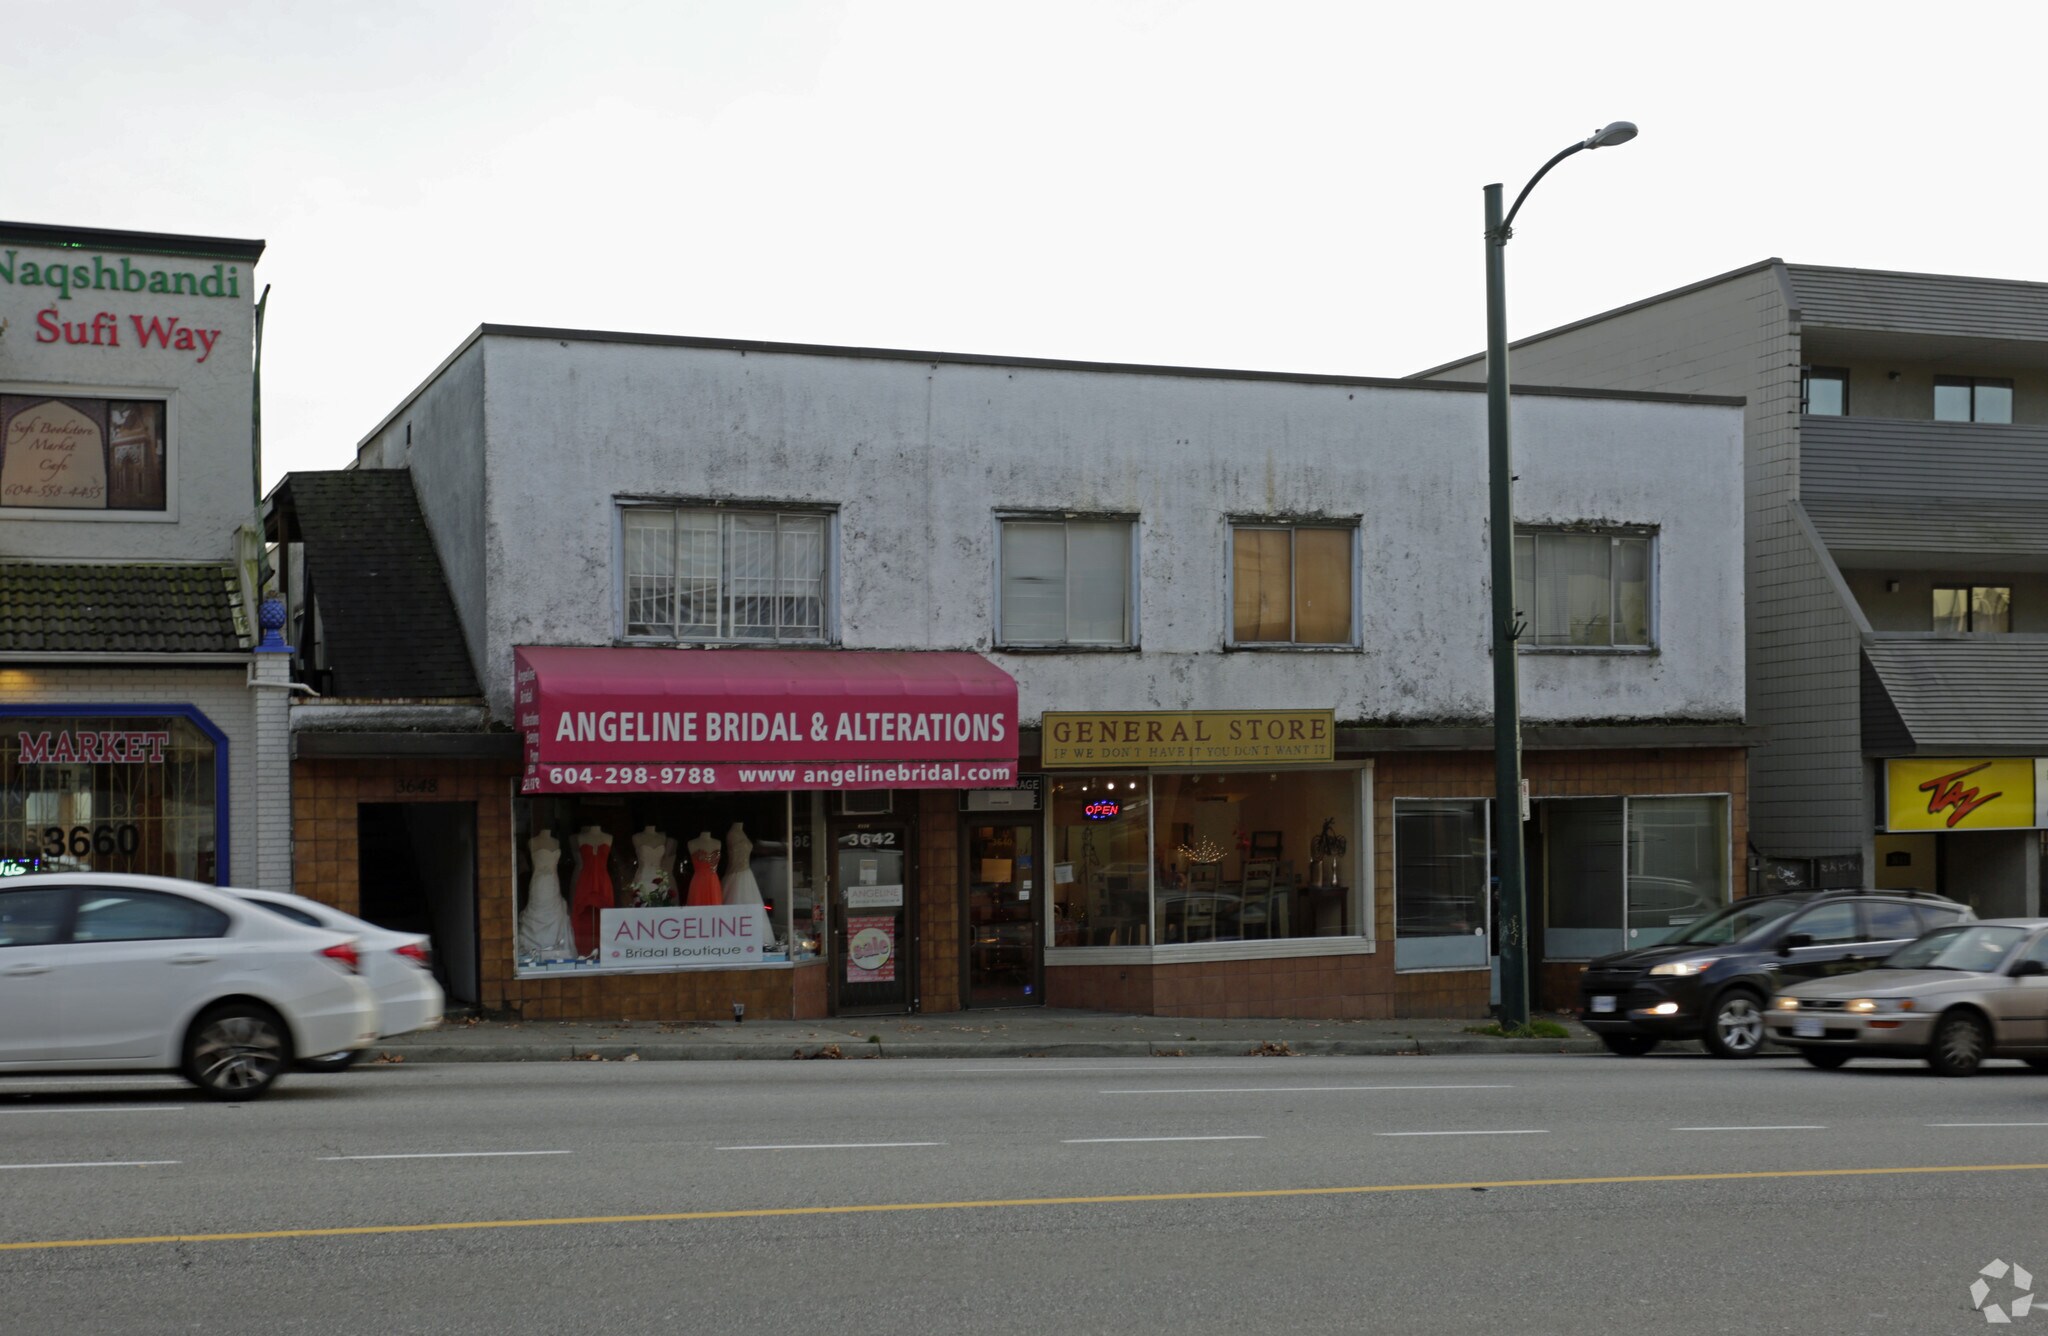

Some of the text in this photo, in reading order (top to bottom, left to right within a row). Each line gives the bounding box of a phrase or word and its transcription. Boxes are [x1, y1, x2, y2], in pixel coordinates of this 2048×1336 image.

[0, 250, 240, 300] Naqshbandi
[36, 308, 221, 363] Sufi Way
[8, 416, 94, 444] Sufi Bookstore
[29, 437, 76, 451] Market
[555, 711, 1005, 743] ANGELINE BRIDAL & ALTERATIONS
[1053, 719, 1327, 743] GENERAL STORE
[18, 730, 169, 763] MARKET
[1054, 748, 1068, 759] IF
[1073, 748, 1094, 759] WE
[1149, 747, 1185, 758] HAVE
[1207, 747, 1230, 757] YOU
[1275, 745, 1310, 756] WANT
[1314, 745, 1327, 755] IT
[549, 767, 716, 785] 604-298-9788
[1085, 805, 1119, 815] OPEN
[44, 823, 140, 857] 3660
[848, 832, 895, 846] 3642
[852, 887, 899, 898] ANGELINE
[614, 916, 753, 941] ANGELINE
[625, 944, 741, 959] Bridal Boutique
[853, 936, 889, 960] sale
